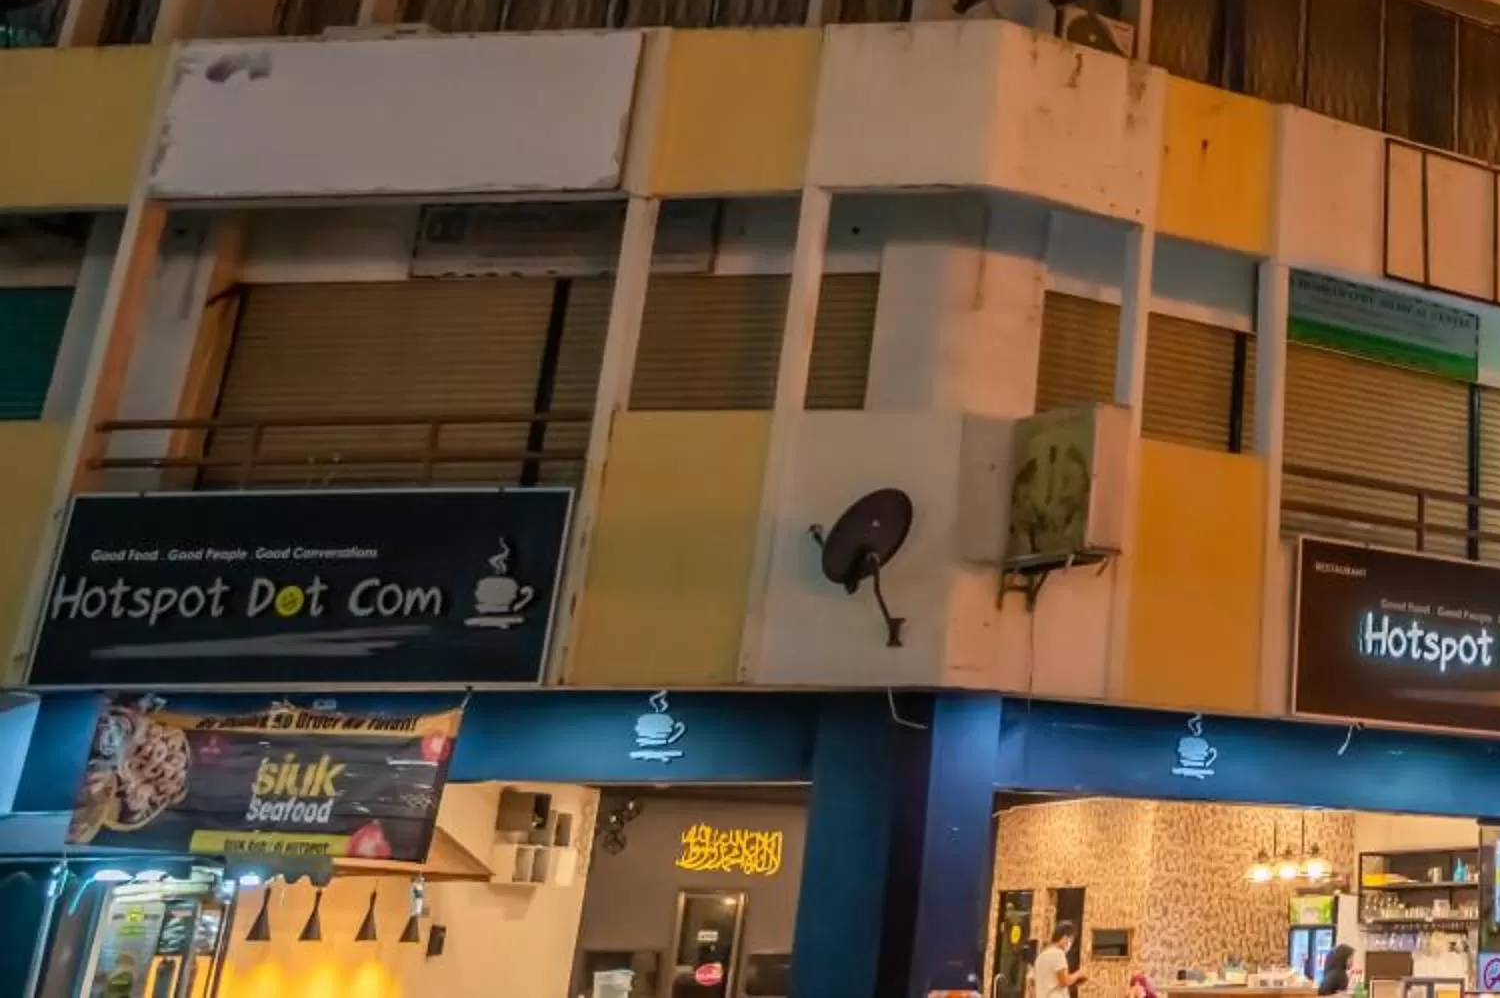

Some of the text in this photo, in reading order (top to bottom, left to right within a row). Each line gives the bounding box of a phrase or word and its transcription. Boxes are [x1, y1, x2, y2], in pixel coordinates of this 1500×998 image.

[91, 549, 127, 561] Good
[128, 549, 159, 561] Food
[167, 549, 204, 561] Good
[205, 547, 248, 564] People
[255, 546, 290, 560] Good
[51, 574, 443, 627] Hotspot Dot Com
[1363, 611, 1494, 673] Hotspot
